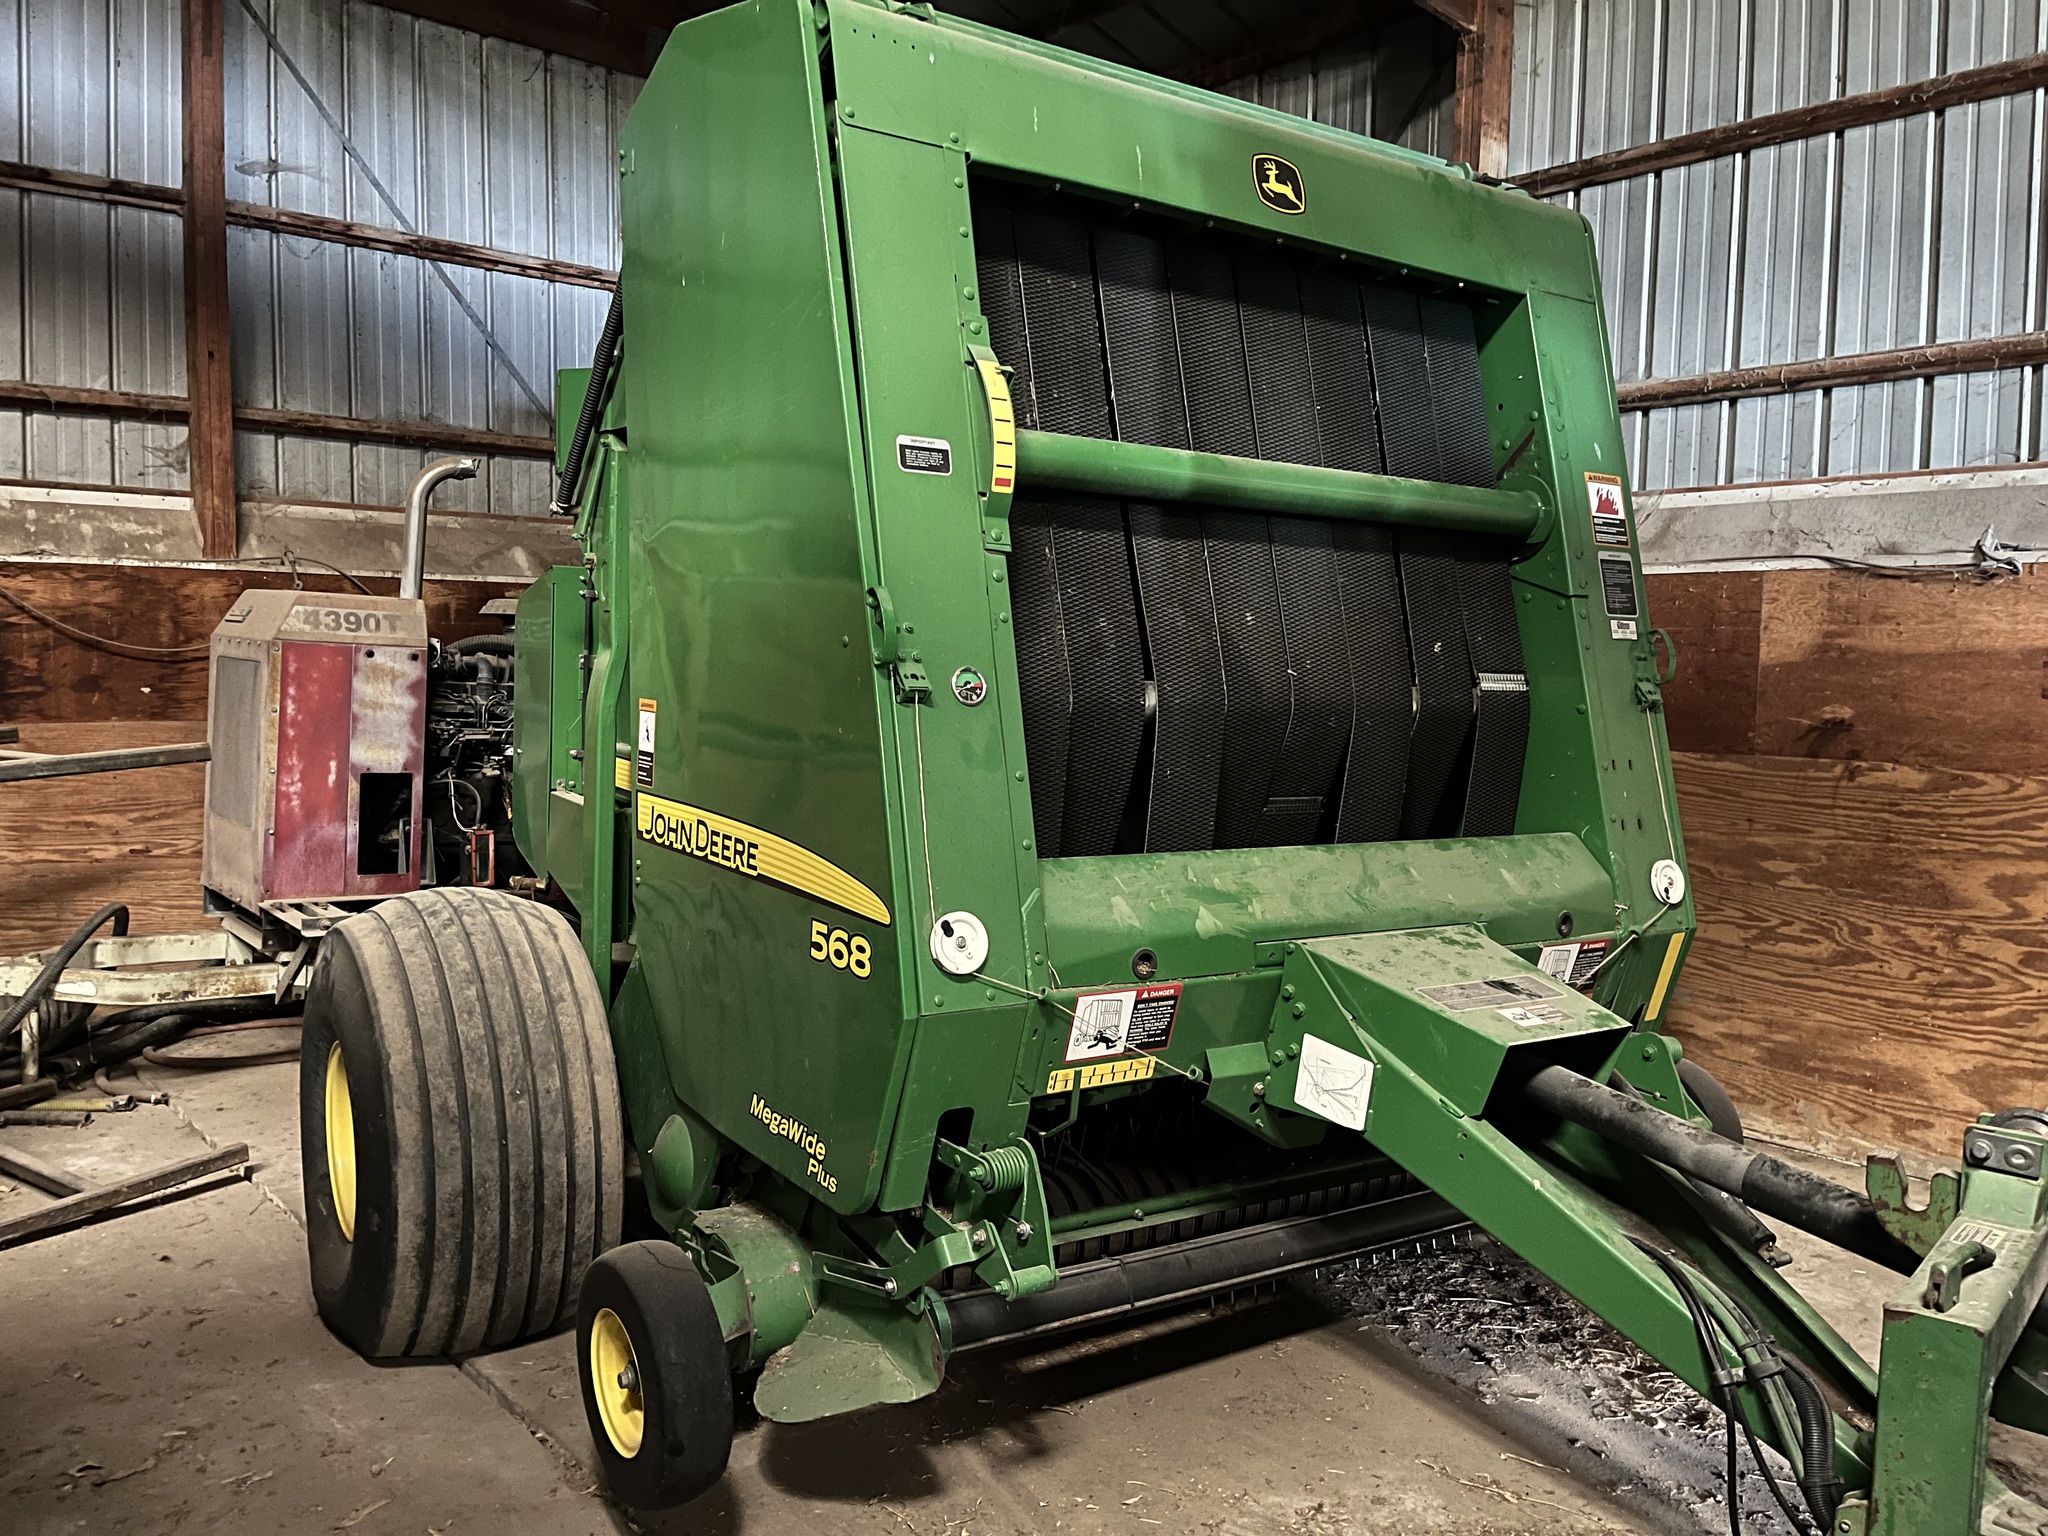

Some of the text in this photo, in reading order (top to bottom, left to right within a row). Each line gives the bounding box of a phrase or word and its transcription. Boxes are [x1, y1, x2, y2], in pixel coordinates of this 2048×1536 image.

[1592, 475, 1618, 484] WARNING
[302, 609, 402, 634] 4390T
[644, 806, 759, 873] JOHN DEERE
[810, 918, 872, 979] 568
[1150, 989, 1175, 997] DANGER
[750, 1093, 827, 1161] MegaWide
[806, 1157, 839, 1194] Plus
